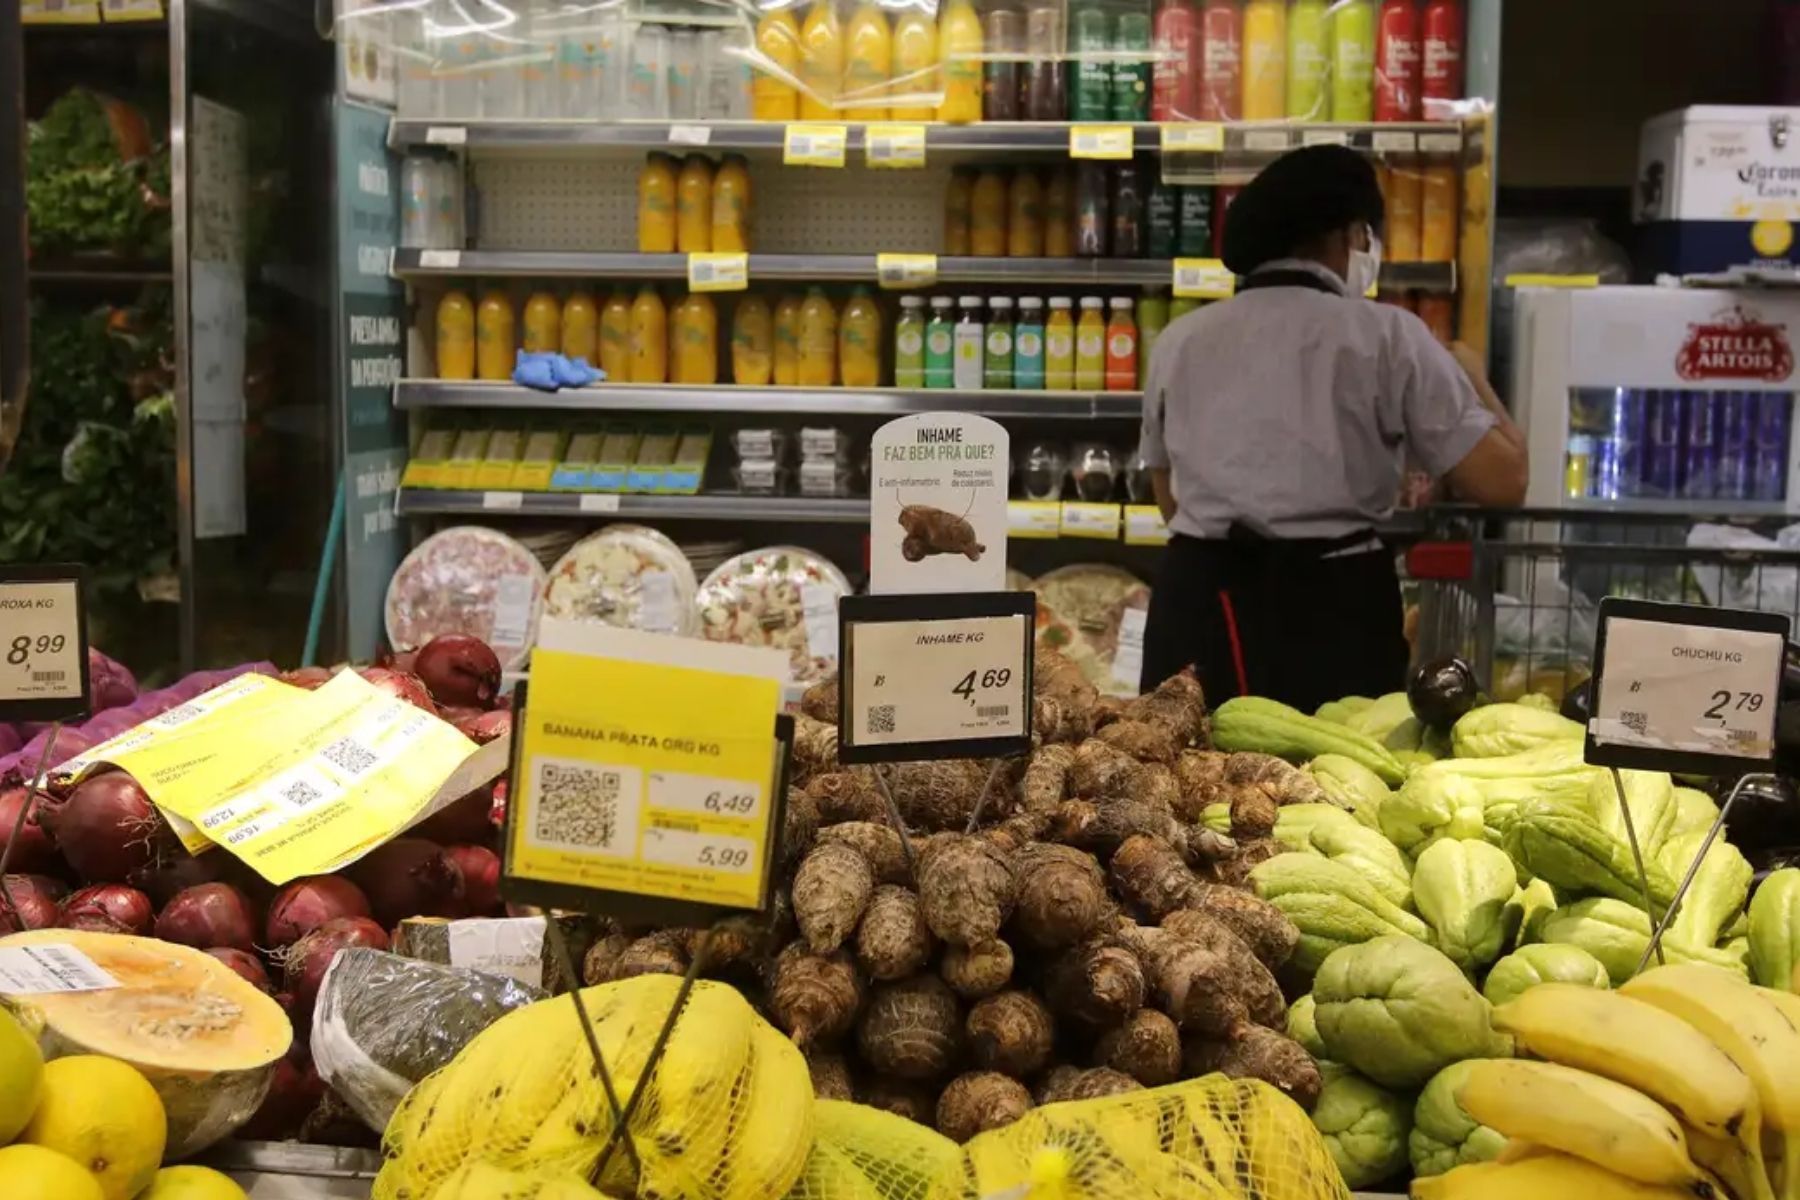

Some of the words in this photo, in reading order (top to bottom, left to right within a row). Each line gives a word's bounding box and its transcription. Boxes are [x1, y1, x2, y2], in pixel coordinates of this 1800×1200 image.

[1699, 335, 1773, 352] STELLA
[1698, 352, 1773, 369] ARTOIS
[917, 428, 963, 443] INHAME
[884, 446, 905, 461] FAZ
[909, 445, 936, 460] BEM
[939, 445, 961, 460] PRA
[965, 444, 995, 460] QUE?
[0, 599, 33, 609] ROXA
[36, 598, 54, 608] KG
[916, 634, 963, 645] INHAME
[965, 632, 984, 642] KG
[7, 635, 65, 673] 8,99
[1672, 647, 1722, 661] CHUCHU
[1725, 652, 1742, 663] KG
[952, 668, 1011, 707] 4,69
[1704, 690, 1763, 727] 2,79
[543, 722, 604, 742] BANANA
[609, 733, 657, 749] PRATA
[662, 738, 695, 754] ORG
[698, 744, 720, 757] KG
[704, 791, 754, 814] 6,49
[697, 846, 748, 868] 5,99
